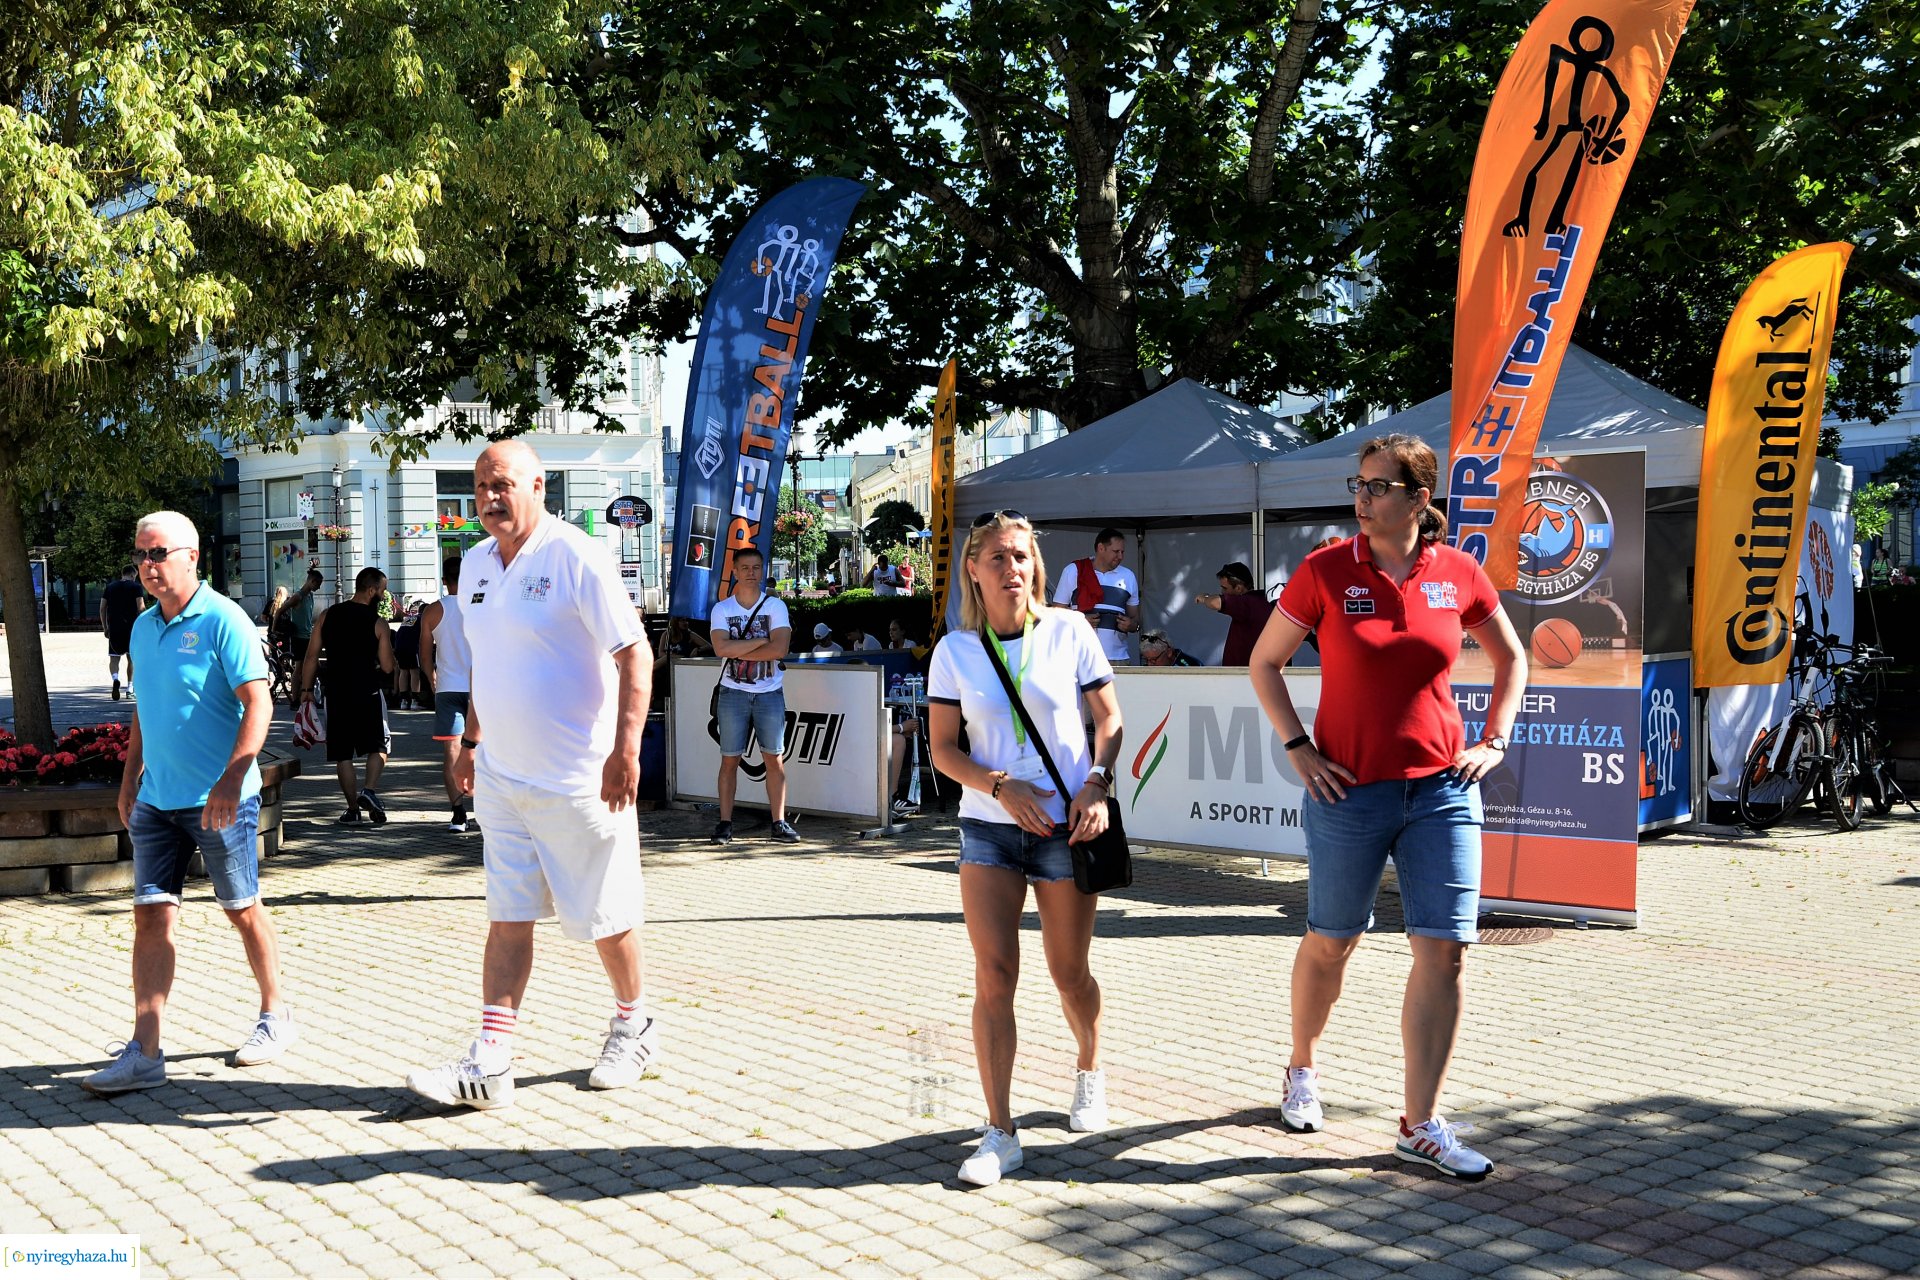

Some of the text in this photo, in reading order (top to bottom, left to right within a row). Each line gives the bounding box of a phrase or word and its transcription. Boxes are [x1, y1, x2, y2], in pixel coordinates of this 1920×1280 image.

[700, 416, 723, 467] TOTI
[1526, 480, 1591, 509] BNER
[1725, 348, 1812, 665] Continental
[1515, 551, 1600, 596] EGYHÁZA BS
[1455, 692, 1556, 714] HÜER
[1463, 718, 1625, 748] YEGYHÁZA
[1582, 752, 1625, 785] BS
[1190, 801, 1203, 820] A
[1208, 802, 1274, 825] SPORT
[1527, 806, 1545, 815] Géza
